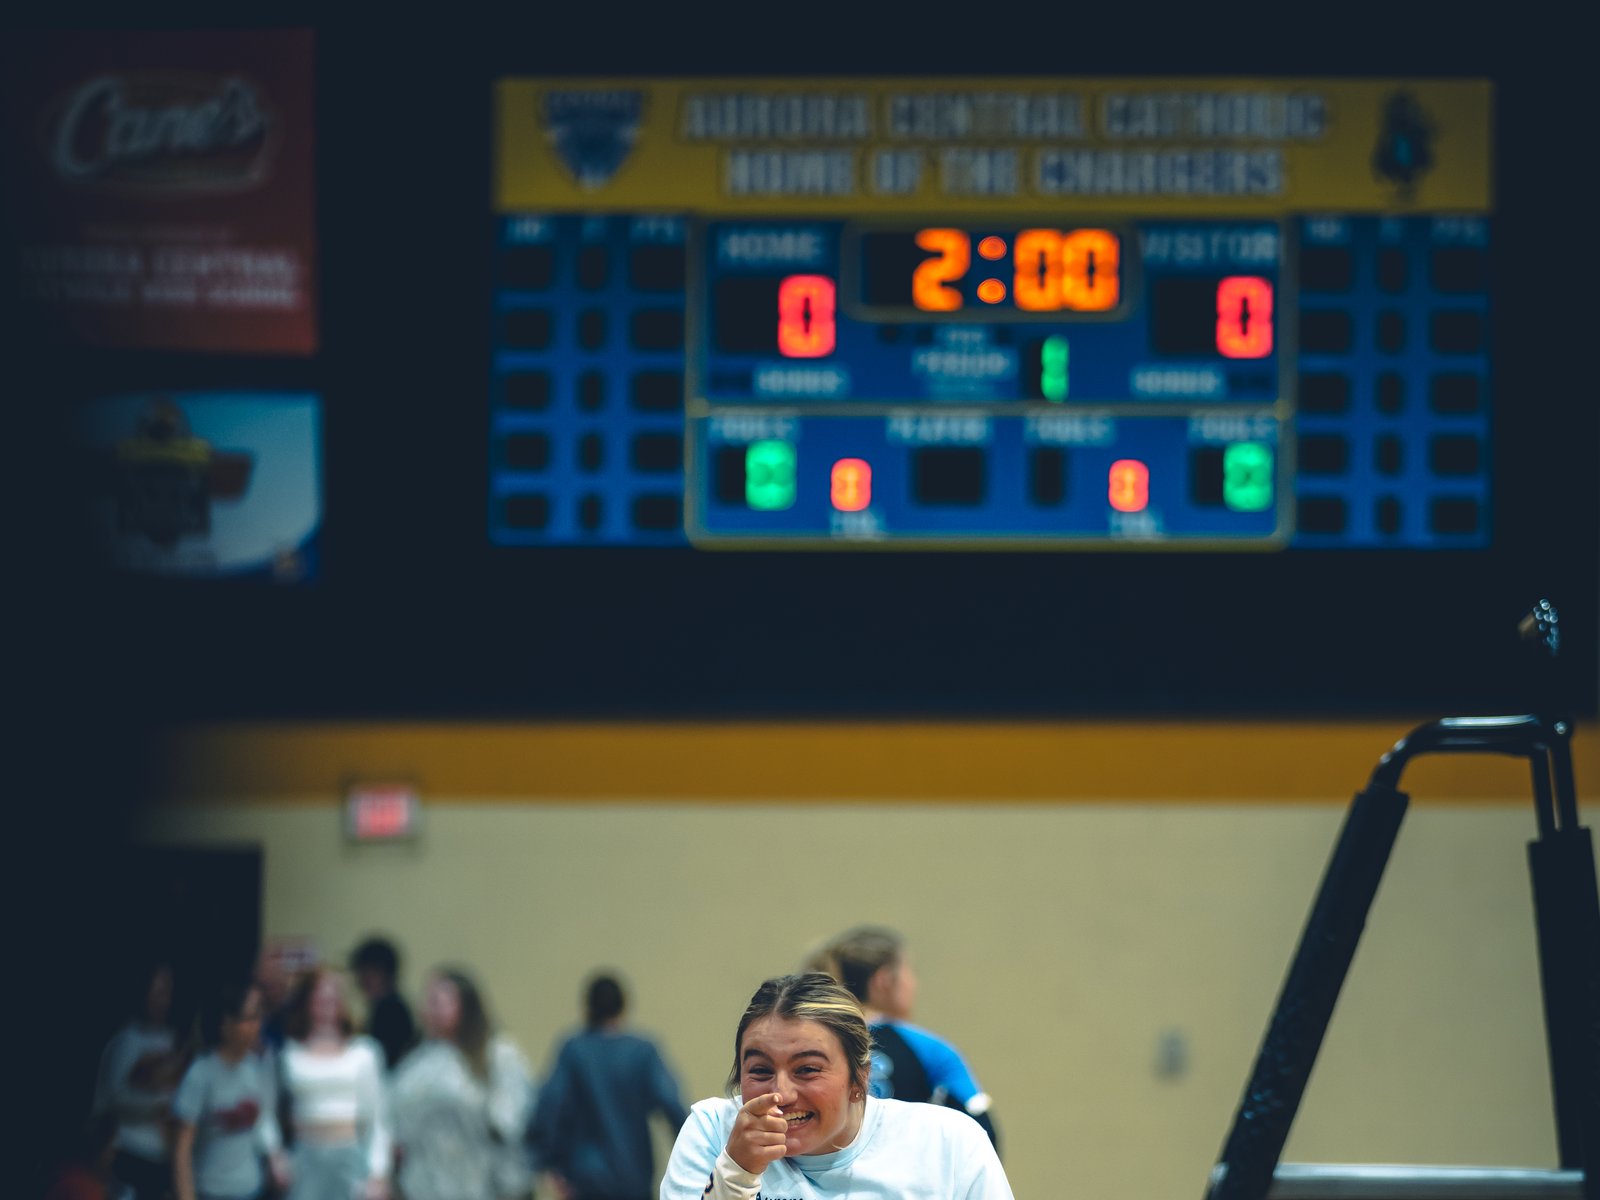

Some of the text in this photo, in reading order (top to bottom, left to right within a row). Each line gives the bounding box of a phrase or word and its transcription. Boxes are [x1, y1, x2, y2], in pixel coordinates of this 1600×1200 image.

[56, 77, 266, 177] Cane's
[684, 93, 867, 138] AURORA
[889, 93, 1084, 138] CENTRAL
[1106, 93, 1327, 138] CATHOLIC
[727, 149, 1284, 194] HOME OF THE CHARGERS
[912, 228, 1120, 312] 2:00
[778, 274, 836, 358] 0
[1216, 275, 1273, 359] 0
